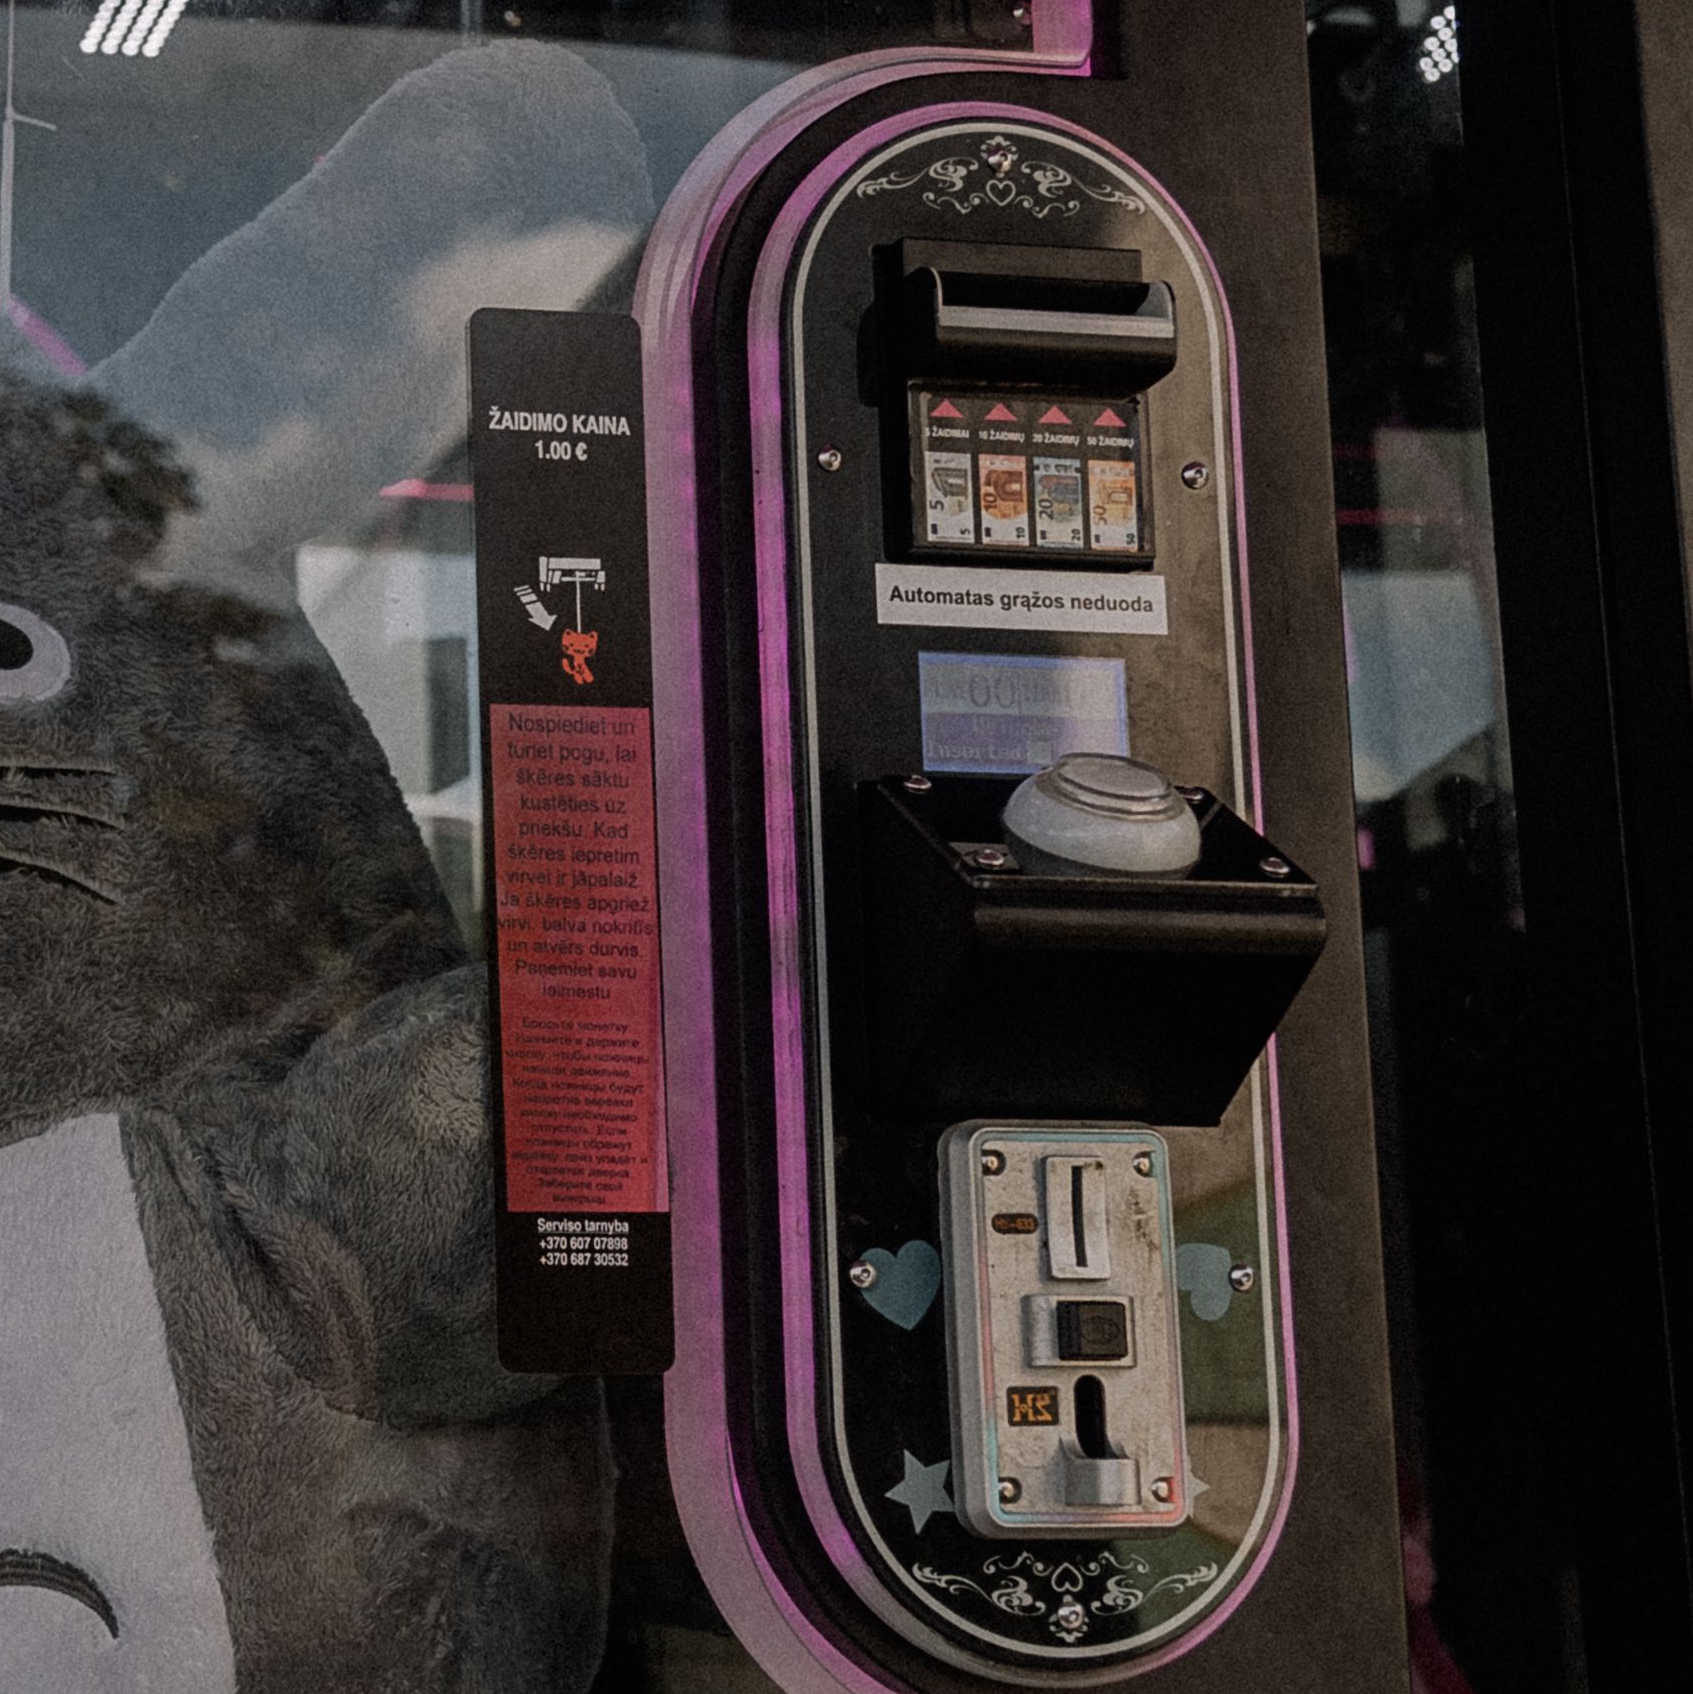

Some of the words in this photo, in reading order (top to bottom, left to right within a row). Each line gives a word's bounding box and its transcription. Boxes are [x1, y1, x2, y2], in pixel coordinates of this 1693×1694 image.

[488, 405, 568, 433] ŽAIDIMO
[572, 414, 631, 436] KAINA
[978, 430, 989, 441] 10
[534, 439, 572, 460] 1.00
[575, 441, 588, 461] €
[929, 500, 945, 511] 5
[983, 492, 998, 512] 10
[1039, 498, 1055, 521] 20
[1092, 505, 1107, 526] 50
[889, 585, 994, 606] Automatas
[999, 590, 1065, 612] grąžos
[1071, 594, 1154, 613] neduoda
[508, 712, 606, 737] Nospiediet
[611, 722, 635, 736] un
[508, 742, 553, 760] turiet
[581, 770, 630, 789] sāktu
[519, 794, 599, 814] kustēties
[605, 800, 626, 815] uz
[593, 820, 628, 839] Kad
[500, 892, 520, 907] Ja
[587, 895, 650, 915] apgriež
[507, 940, 528, 953] un
[597, 964, 637, 979] savu
[537, 1217, 582, 1233] Serviso
[584, 1219, 629, 1235] tarnyba
[539, 1236, 568, 1250] +370
[569, 1236, 591, 1250] 607
[593, 1237, 629, 1250] 07898
[539, 1252, 568, 1266] +370
[569, 1252, 591, 1266] 687
[593, 1253, 629, 1267] 30532
